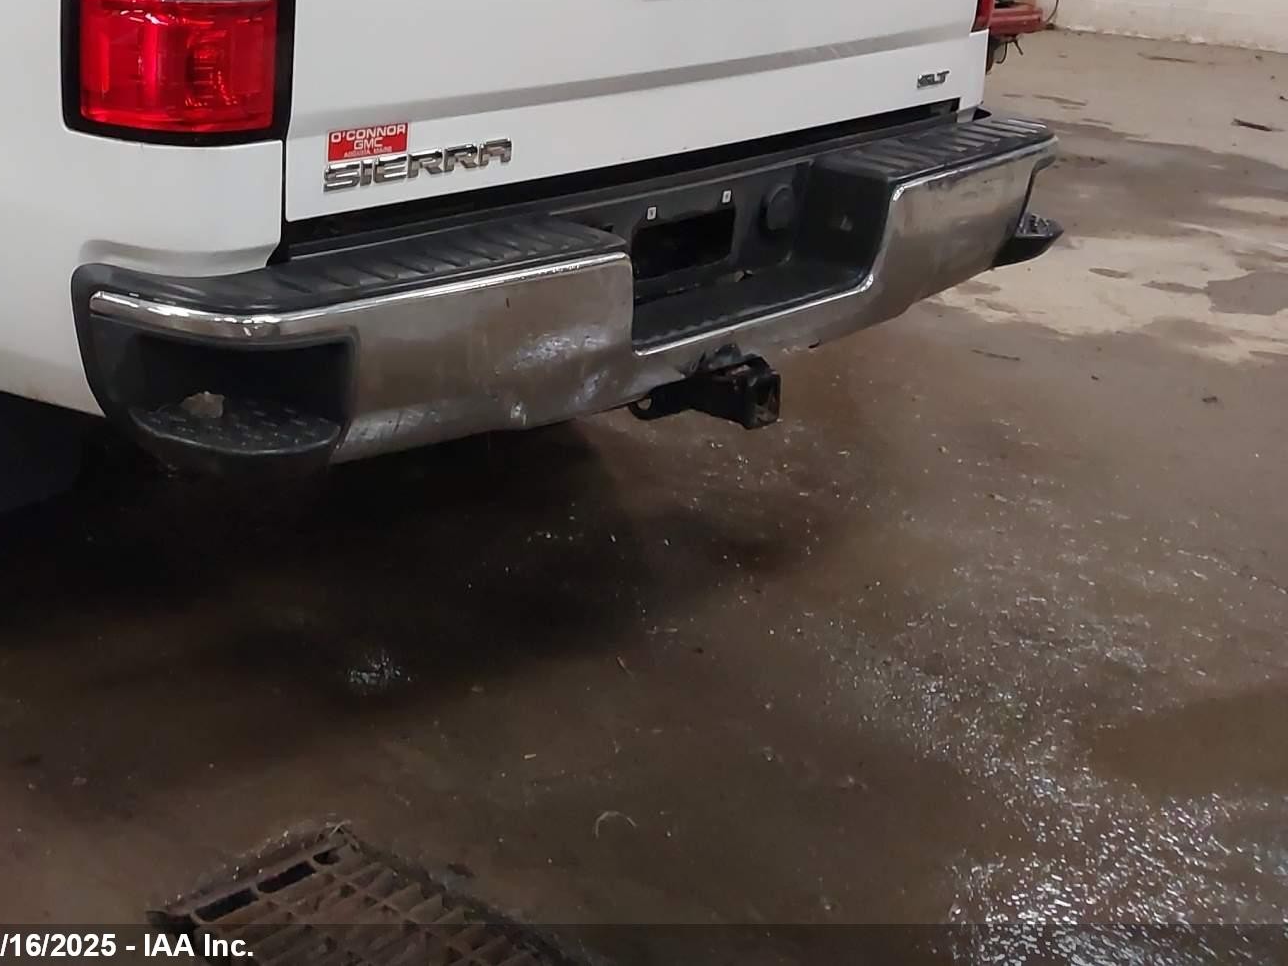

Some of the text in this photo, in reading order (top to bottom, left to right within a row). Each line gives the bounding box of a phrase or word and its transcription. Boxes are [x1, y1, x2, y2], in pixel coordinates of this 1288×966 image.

[331, 124, 406, 143] O'CONNOR
[354, 137, 383, 150] GMC
[323, 137, 512, 192] SIERRA
